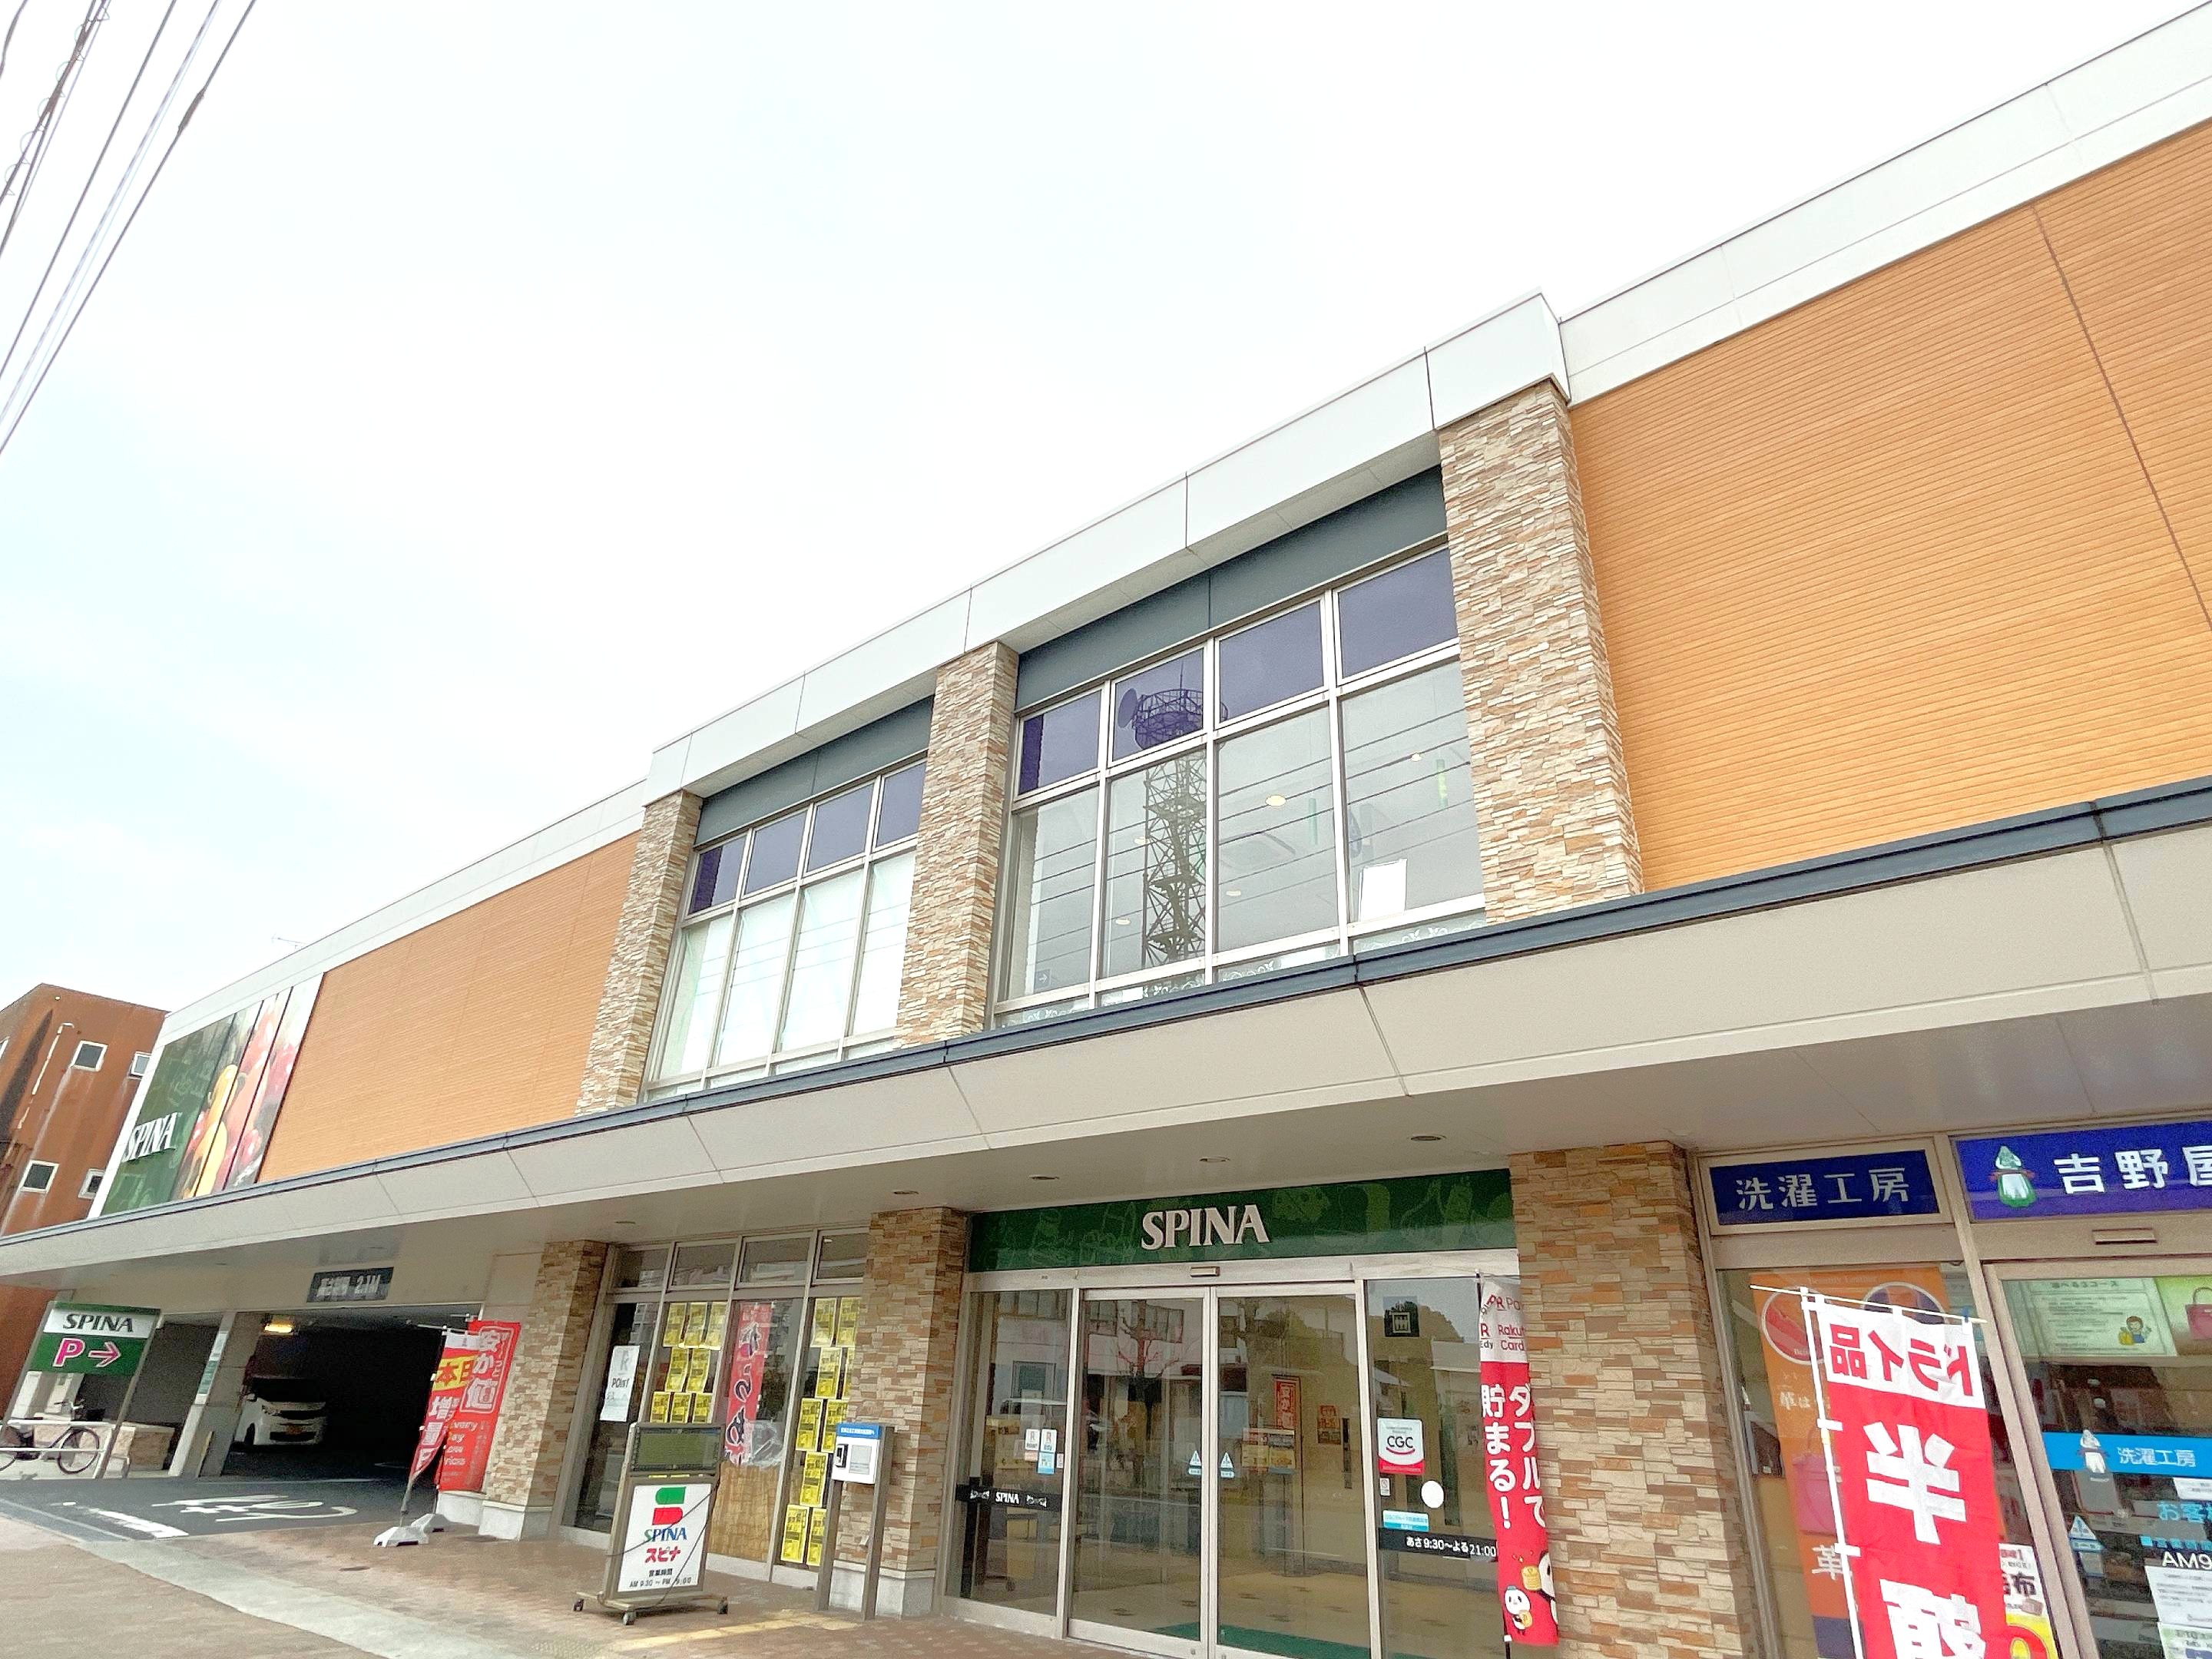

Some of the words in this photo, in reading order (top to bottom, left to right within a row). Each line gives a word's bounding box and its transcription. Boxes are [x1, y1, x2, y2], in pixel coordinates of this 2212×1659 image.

[121, 1112, 180, 1162] SPINA
[1736, 1167, 1909, 1210] 洗濯工房
[1141, 1204, 1270, 1250] SPINA
[1506, 1296, 1524, 1310] Po
[63, 1313, 134, 1333] SPINA
[52, 1338, 85, 1367] P
[1500, 1339, 1525, 1351] Card
[1387, 1435, 1414, 1449] CGC
[2118, 1447, 2197, 1468] 洗濯工房
[995, 1491, 1020, 1505] SPINA
[2157, 1501, 2212, 1524] お客
[644, 1527, 687, 1542] SPINA
[645, 1545, 681, 1563] スピナ
